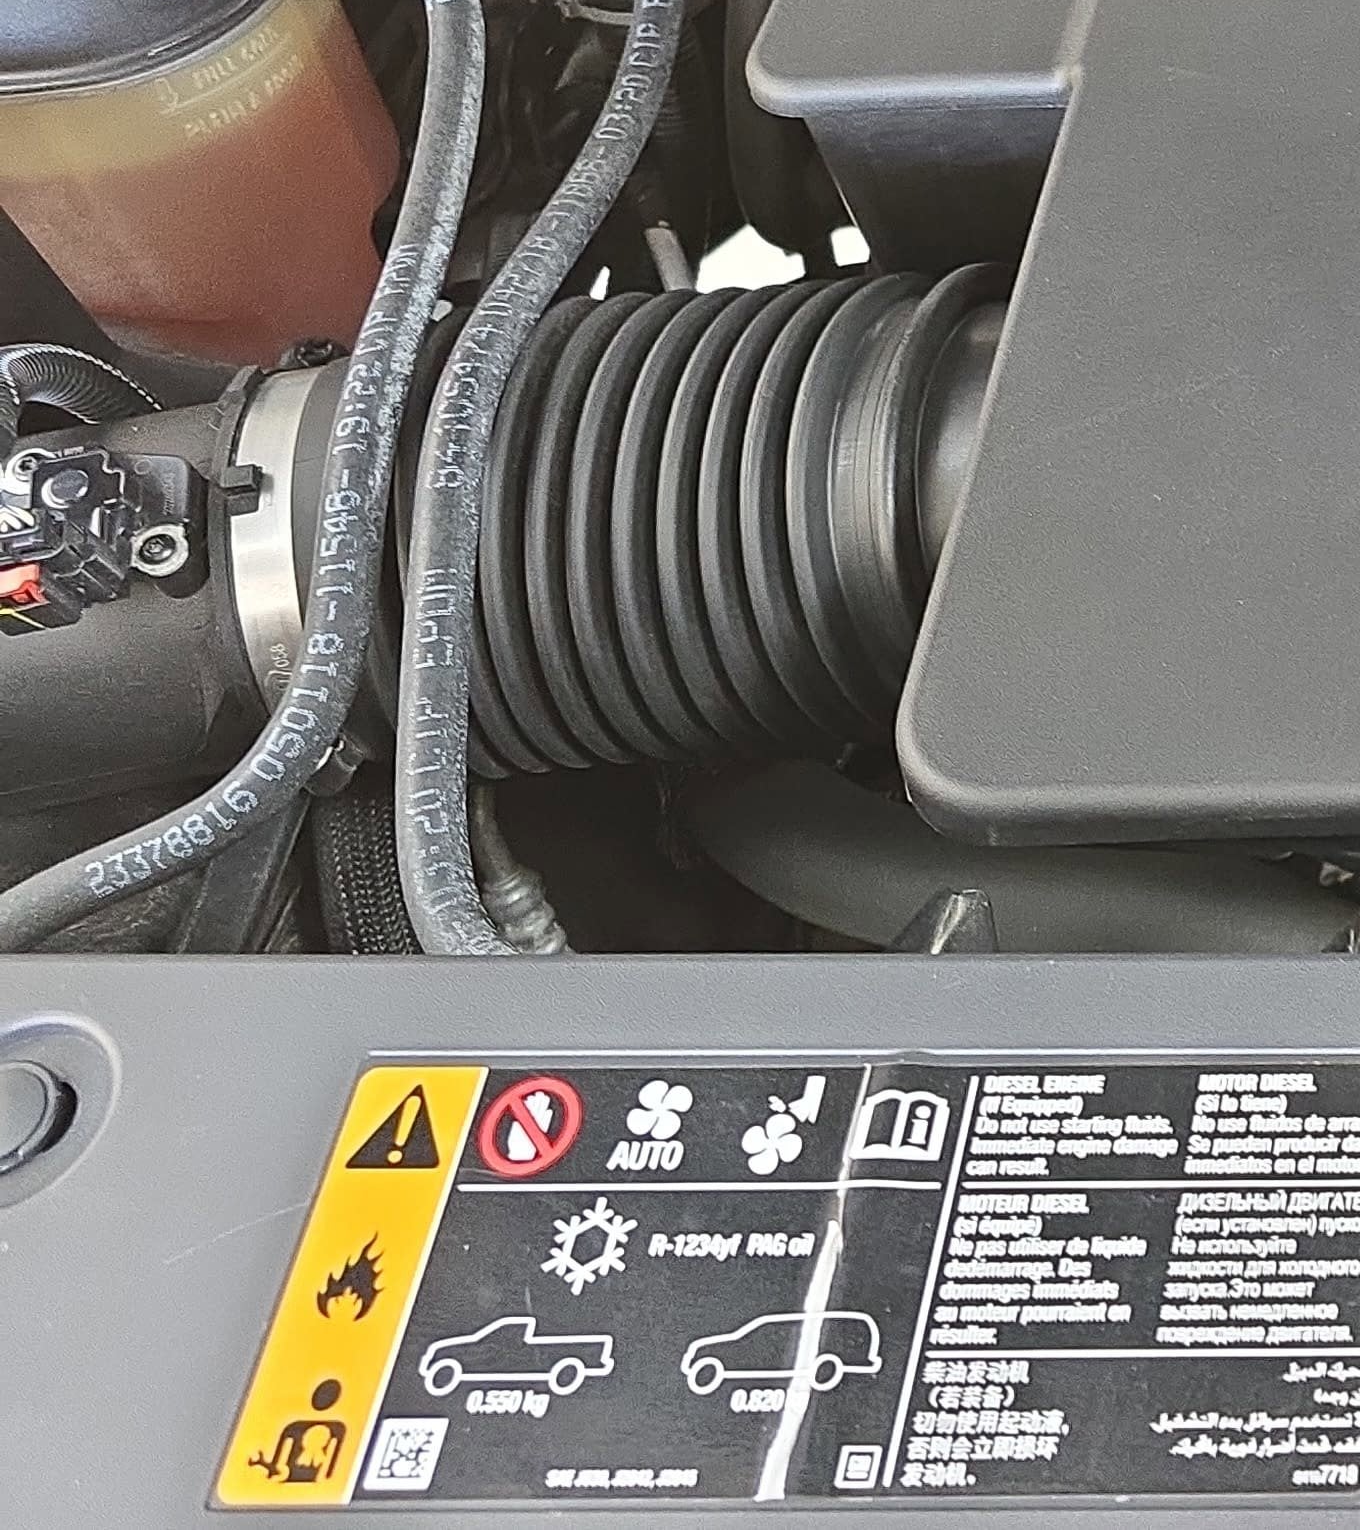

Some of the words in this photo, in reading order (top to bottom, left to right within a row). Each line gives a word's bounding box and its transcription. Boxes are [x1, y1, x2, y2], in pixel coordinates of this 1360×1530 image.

[984, 1075, 1042, 1093] DIESEL
[1043, 1074, 1106, 1094] ENGINE
[1198, 1074, 1259, 1092] MOTOR
[1260, 1073, 1317, 1092] DIESEL
[1001, 1095, 1083, 1117] Equipped)
[1240, 1094, 1287, 1115] tiene)
[975, 1117, 999, 1134] Do
[1000, 1117, 1029, 1134] not
[1029, 1119, 1060, 1134] use
[1060, 1116, 1123, 1137] starting
[1191, 1114, 1216, 1132] No
[1217, 1117, 1248, 1132] use
[1304, 1114, 1327, 1132] de
[606, 1140, 685, 1171] AUTO
[970, 1136, 1055, 1155] Immediate
[1056, 1136, 1112, 1158] engine
[1112, 1136, 1179, 1158] damage
[1187, 1135, 1211, 1154] Se
[1212, 1135, 1272, 1156] pueden
[1273, 1135, 1341, 1156] producir
[966, 1160, 998, 1176] can
[1274, 1158, 1296, 1174] en
[1297, 1155, 1315, 1173] el
[957, 1194, 1030, 1214] MOTEUR
[1030, 1194, 1090, 1214] DIESEL
[1176, 1190, 1287, 1215] ДИЗЕЛЬНЫЙ
[648, 1232, 743, 1262] R-1234yf
[745, 1232, 788, 1258] PAG
[787, 1232, 816, 1258] oil
[948, 1237, 974, 1256] Ne
[974, 1239, 1006, 1259] pas
[1065, 1237, 1089, 1256] de
[1171, 1236, 1196, 1255] Не
[1057, 1258, 1092, 1278] Des
[939, 1280, 1031, 1303] dommages
[959, 1303, 1021, 1322] moteur
[1107, 1305, 1132, 1322] en
[465, 1389, 521, 1414] 0.550
[522, 1389, 551, 1419] kg
[730, 1388, 785, 1413] 0.820
